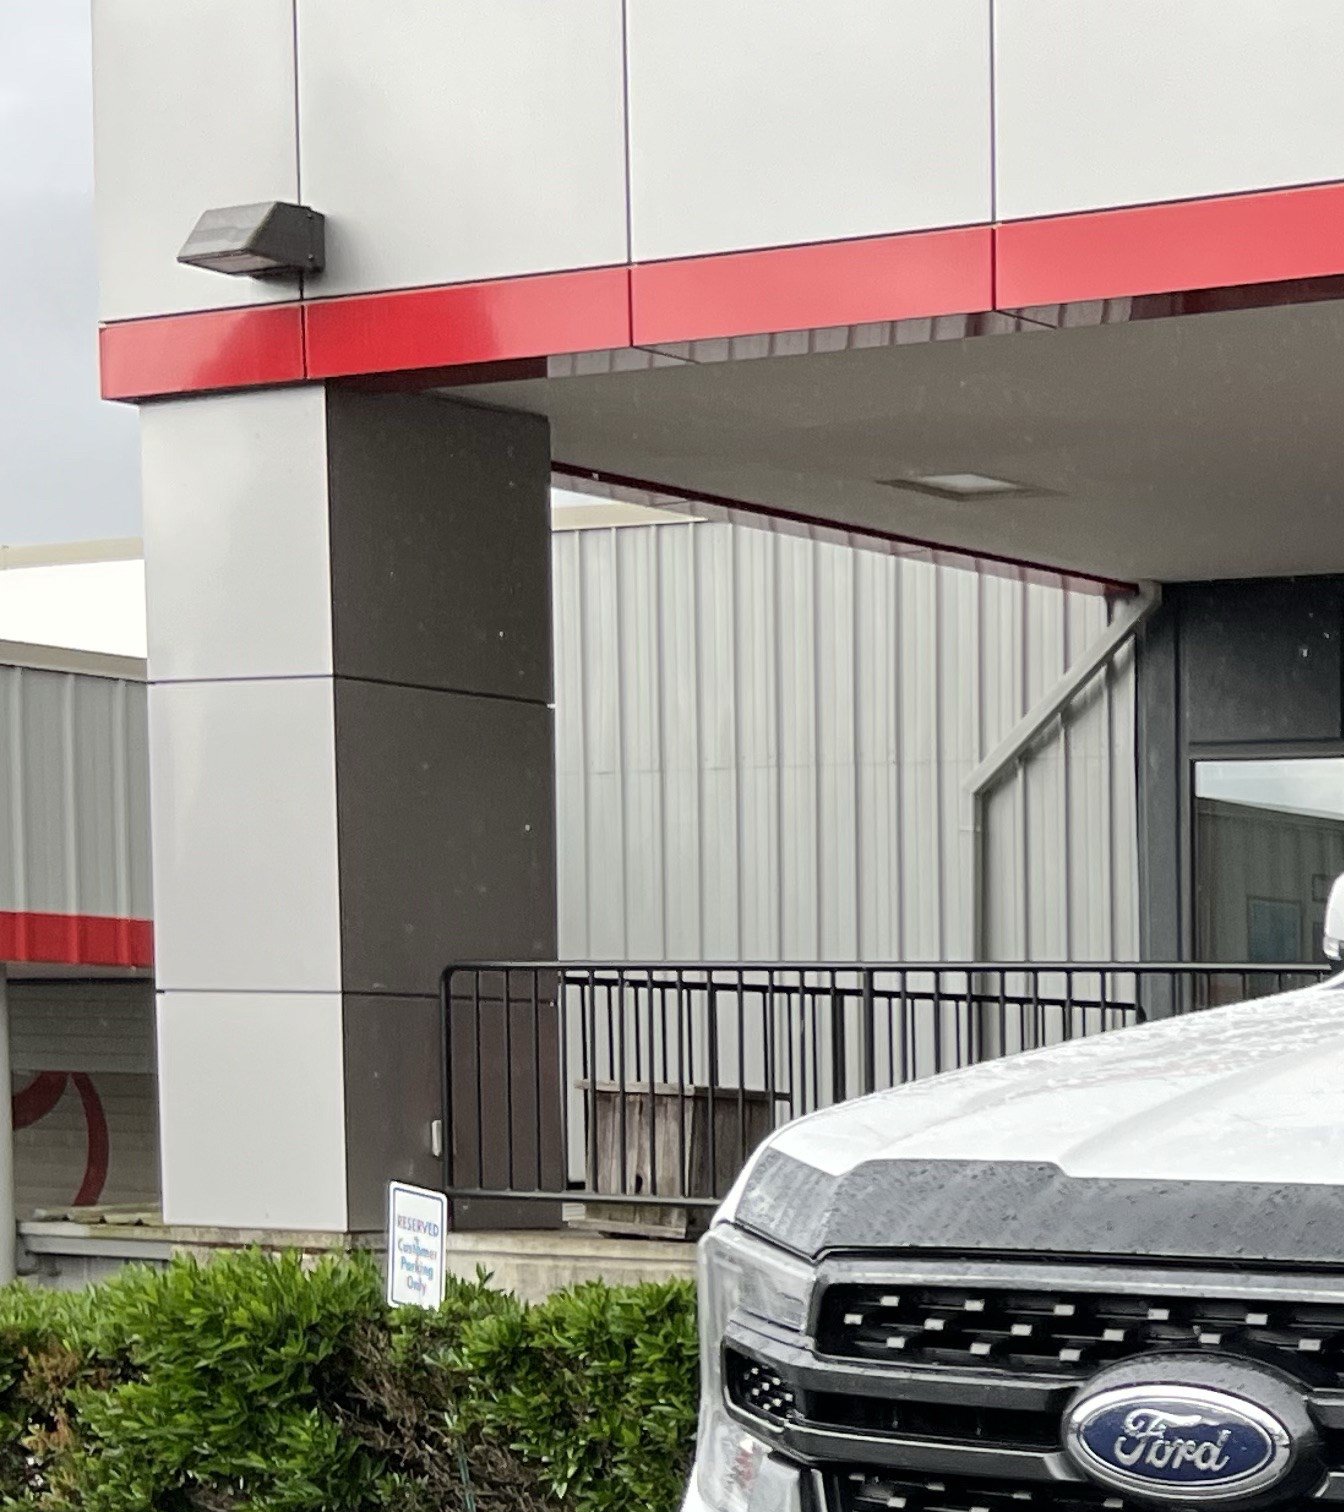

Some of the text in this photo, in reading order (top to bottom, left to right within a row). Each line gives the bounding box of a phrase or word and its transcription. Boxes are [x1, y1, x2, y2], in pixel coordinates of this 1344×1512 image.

[397, 1215, 439, 1237] RESERVED
[401, 1255, 433, 1281] Parking
[1114, 1408, 1231, 1472] Ford
